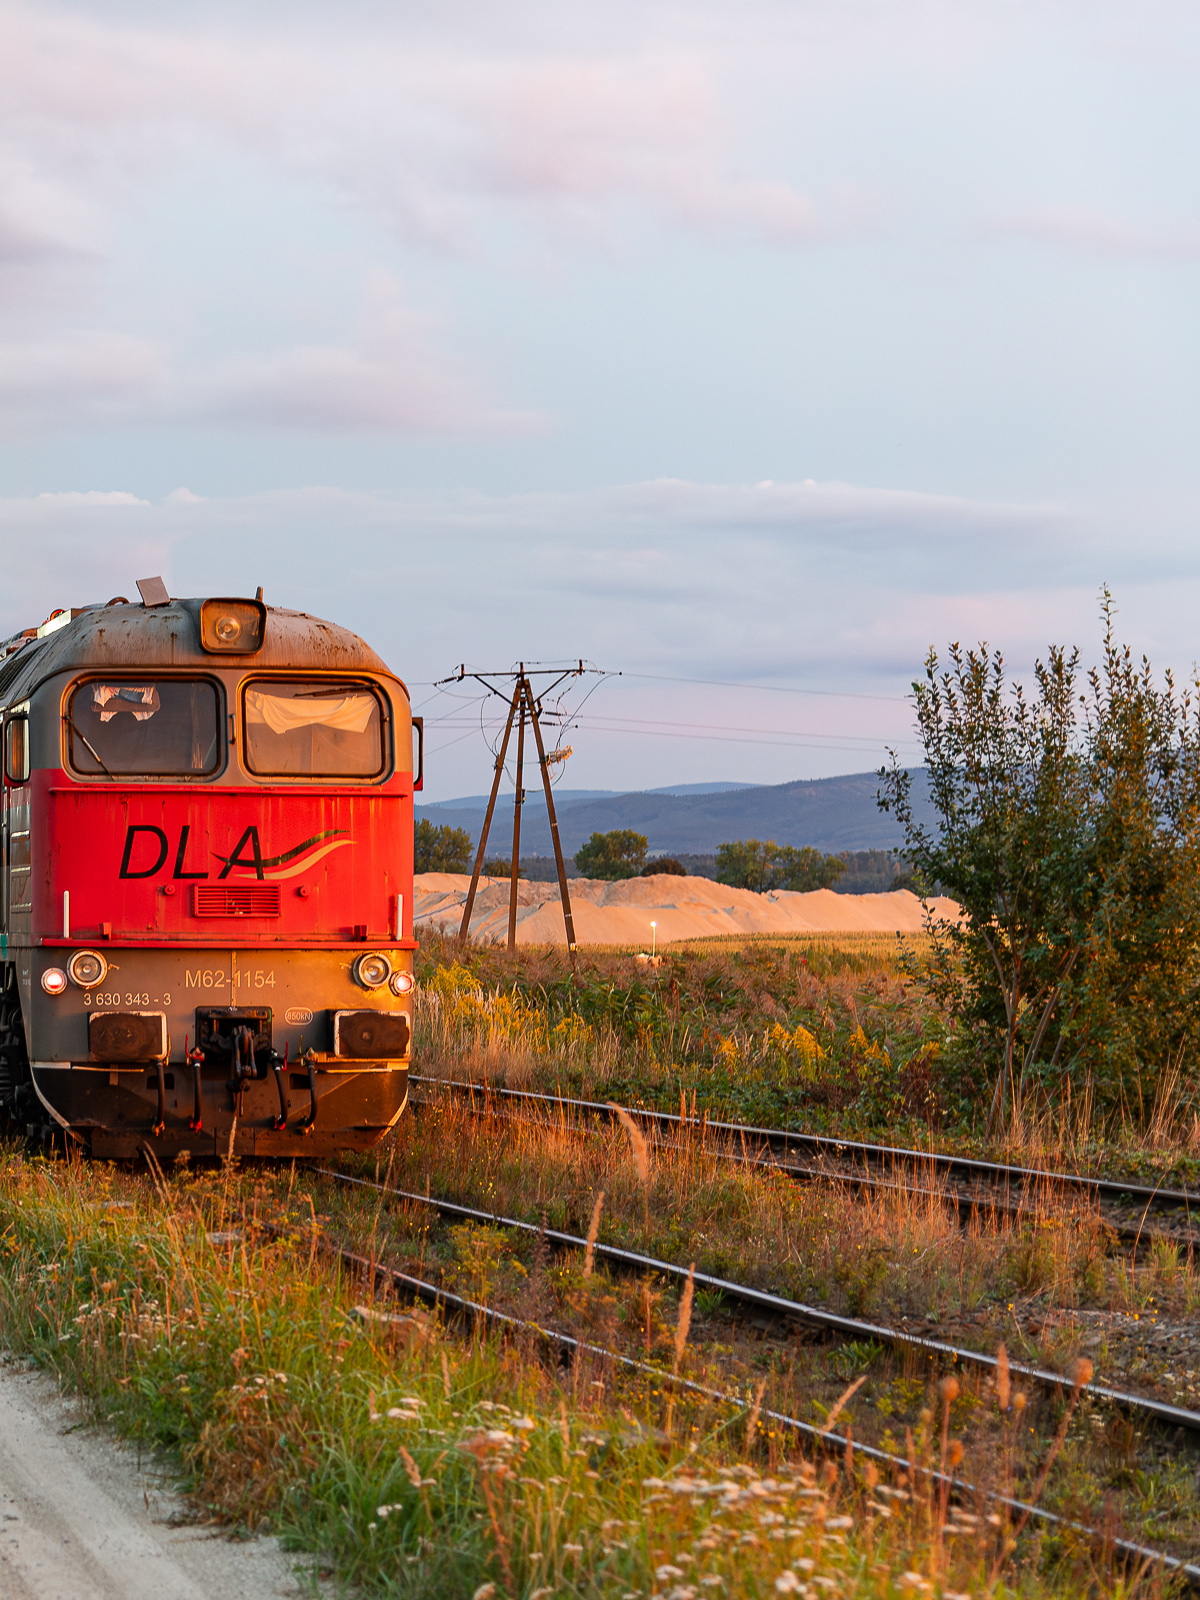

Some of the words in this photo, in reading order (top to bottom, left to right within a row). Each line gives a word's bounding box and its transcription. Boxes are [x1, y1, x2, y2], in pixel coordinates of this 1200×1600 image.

[118, 825, 265, 880] DLA
[185, 970, 276, 988] M62-1154
[83, 993, 92, 1006] 3
[96, 993, 121, 1006] 630
[125, 993, 150, 1006] 343
[163, 993, 172, 1006] 3
[287, 1011, 311, 1021] 850kN
